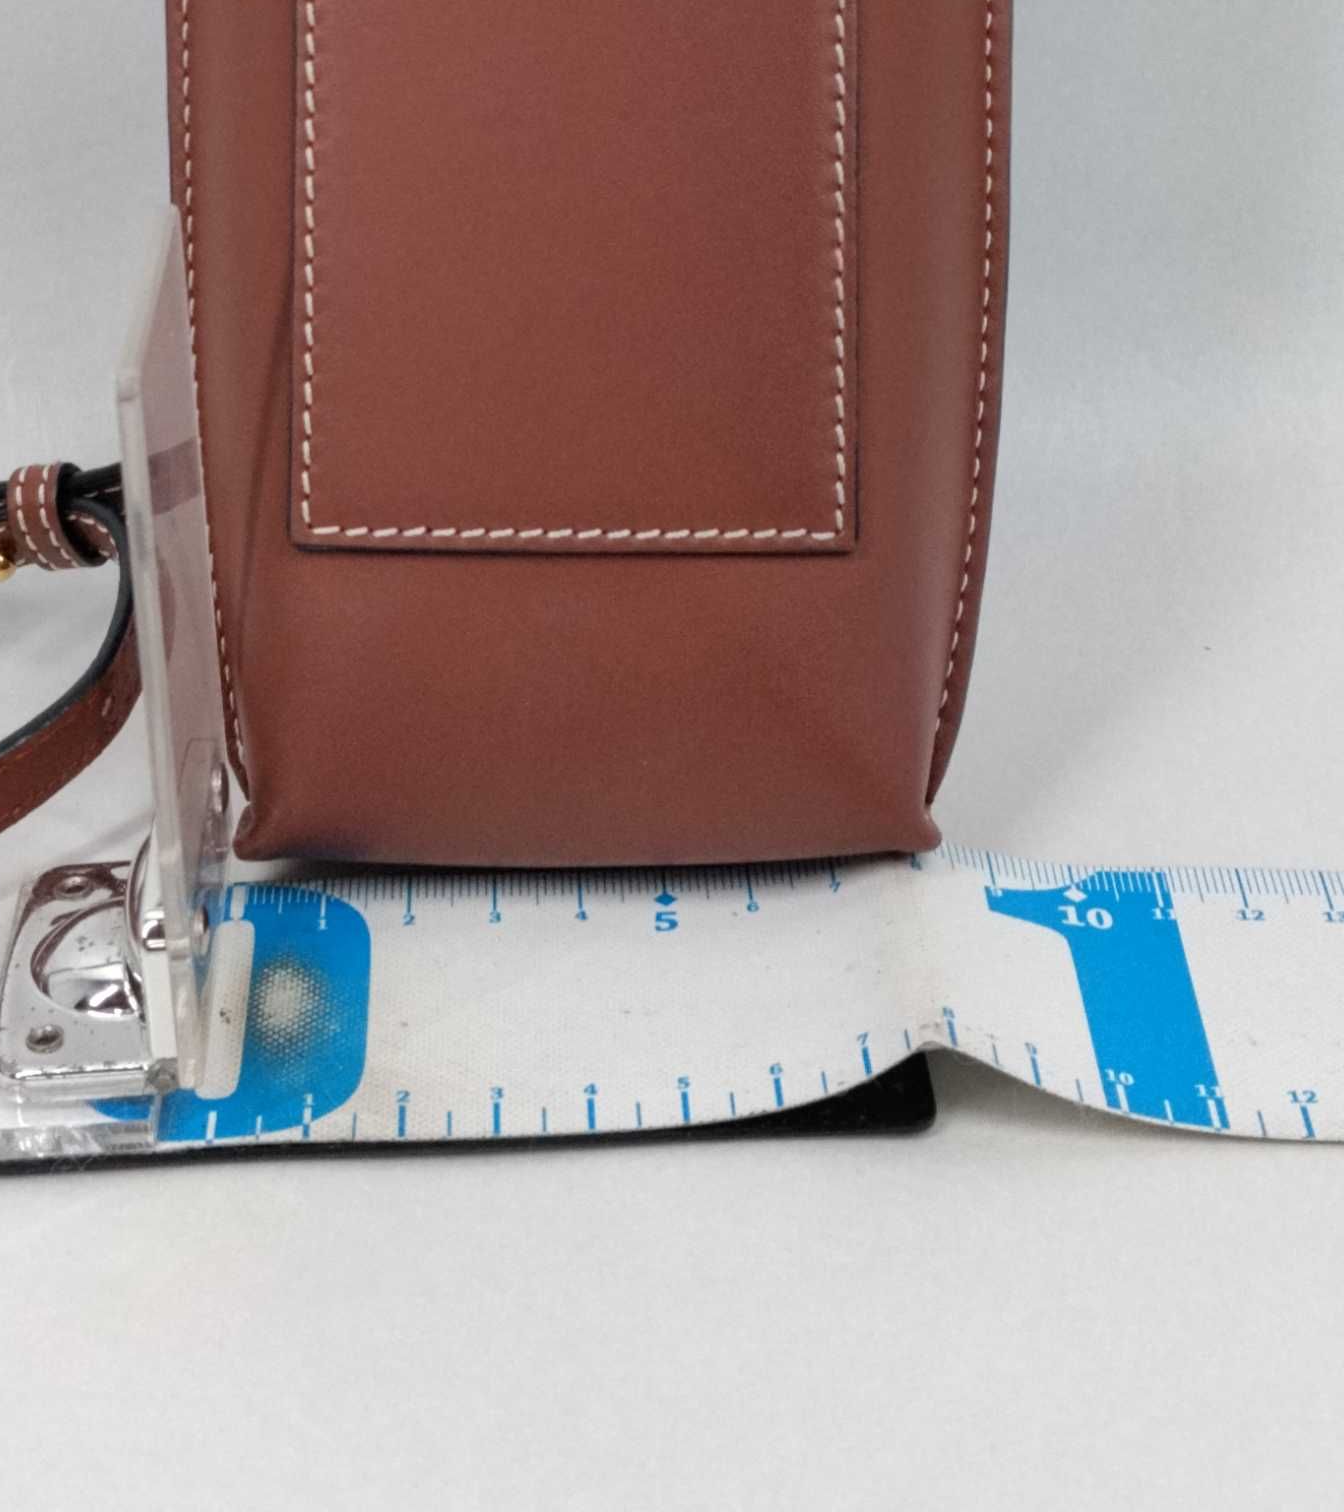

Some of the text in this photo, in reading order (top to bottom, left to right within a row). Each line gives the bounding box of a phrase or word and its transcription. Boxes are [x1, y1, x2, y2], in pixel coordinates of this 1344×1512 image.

[654, 912, 679, 932] 5
[1061, 905, 1114, 929] 10
[1237, 909, 1265, 922] 12
[985, 871, 1231, 1130] 1
[1105, 1070, 1135, 1086] 10
[1195, 1084, 1225, 1099] 11
[1287, 1090, 1317, 1104] 12
